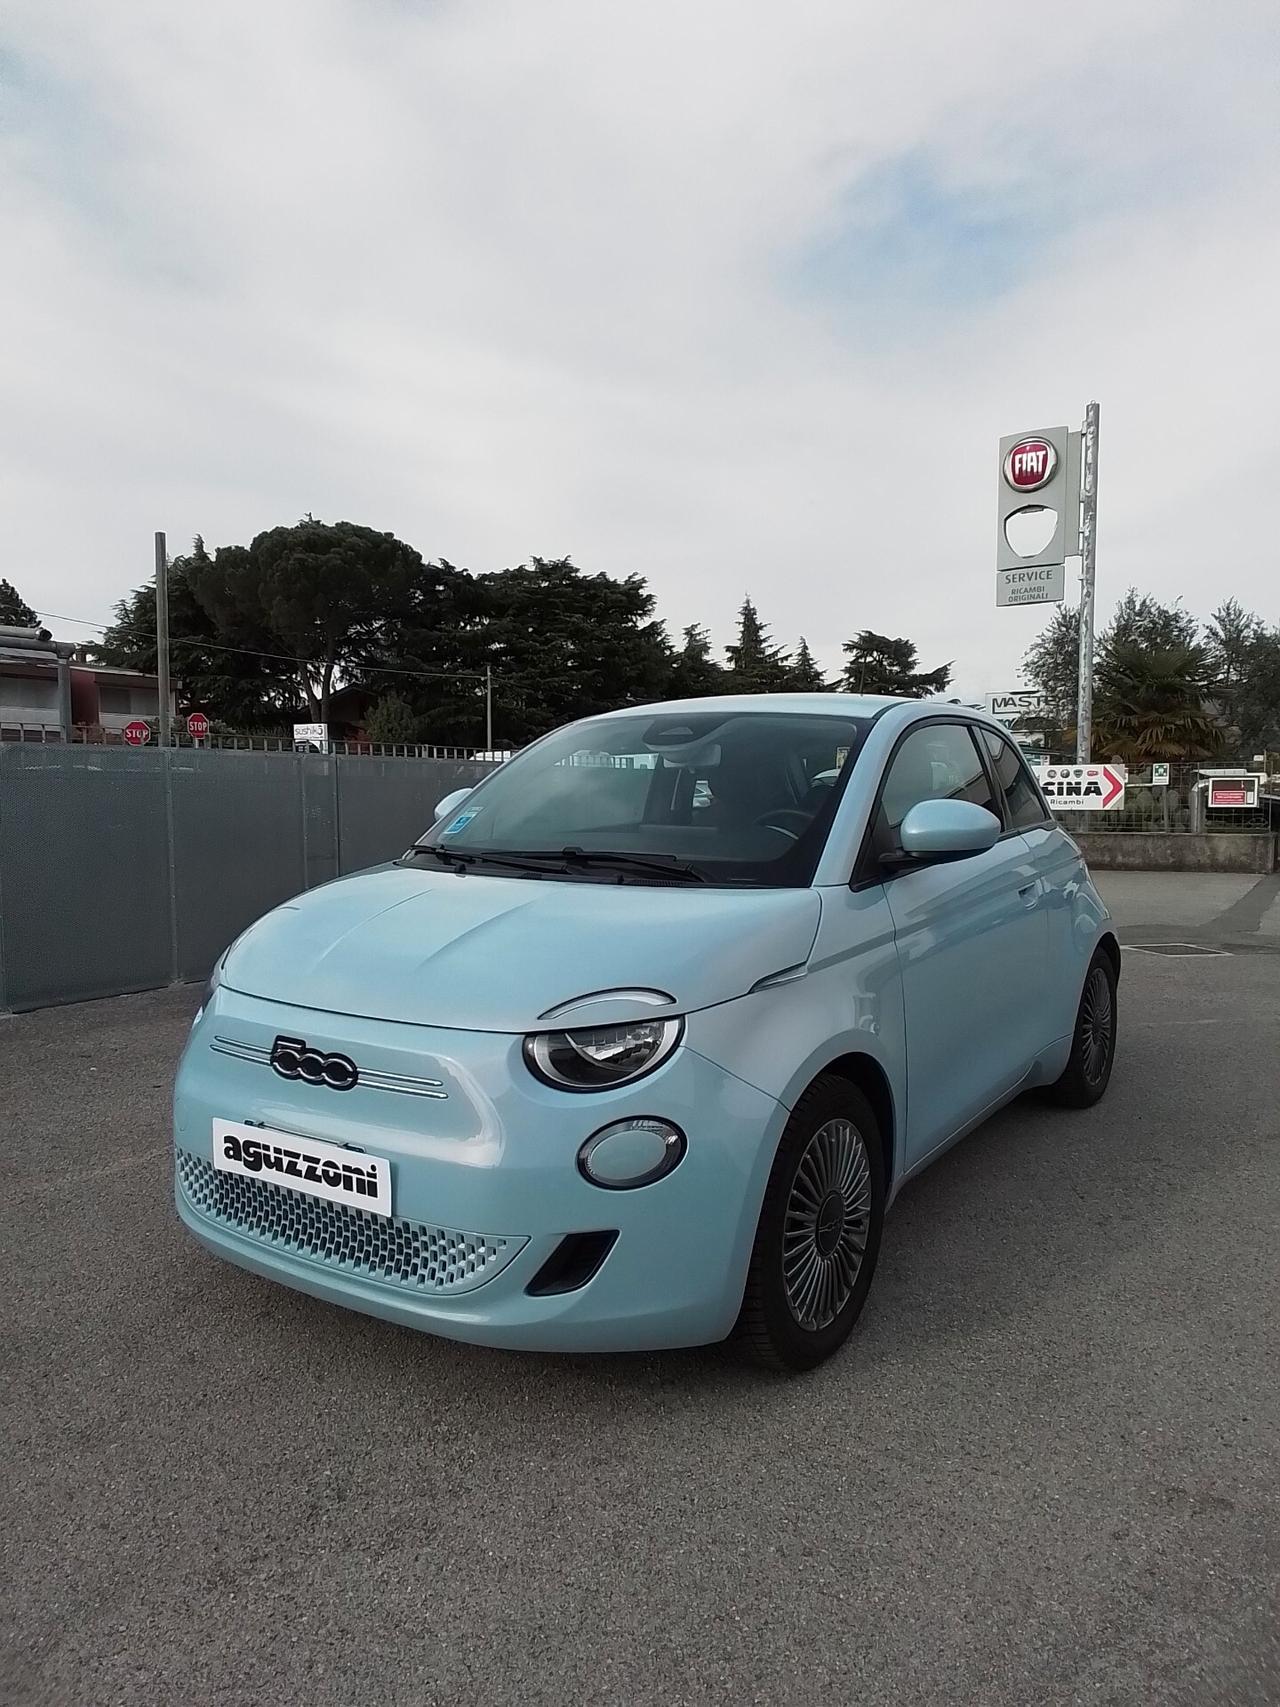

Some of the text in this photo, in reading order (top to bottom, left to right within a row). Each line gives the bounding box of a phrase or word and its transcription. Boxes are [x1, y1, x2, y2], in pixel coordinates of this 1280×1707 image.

[1014, 450, 1046, 475] FIAT
[1005, 570, 1053, 584] SERVICE
[1011, 586, 1045, 595] RICAMBI
[1008, 593, 1048, 603] ORIGINALI
[189, 721, 208, 731] STOP
[126, 728, 149, 738] STOP
[270, 1035, 358, 1090] 500
[223, 1134, 379, 1198] aguzzoni
